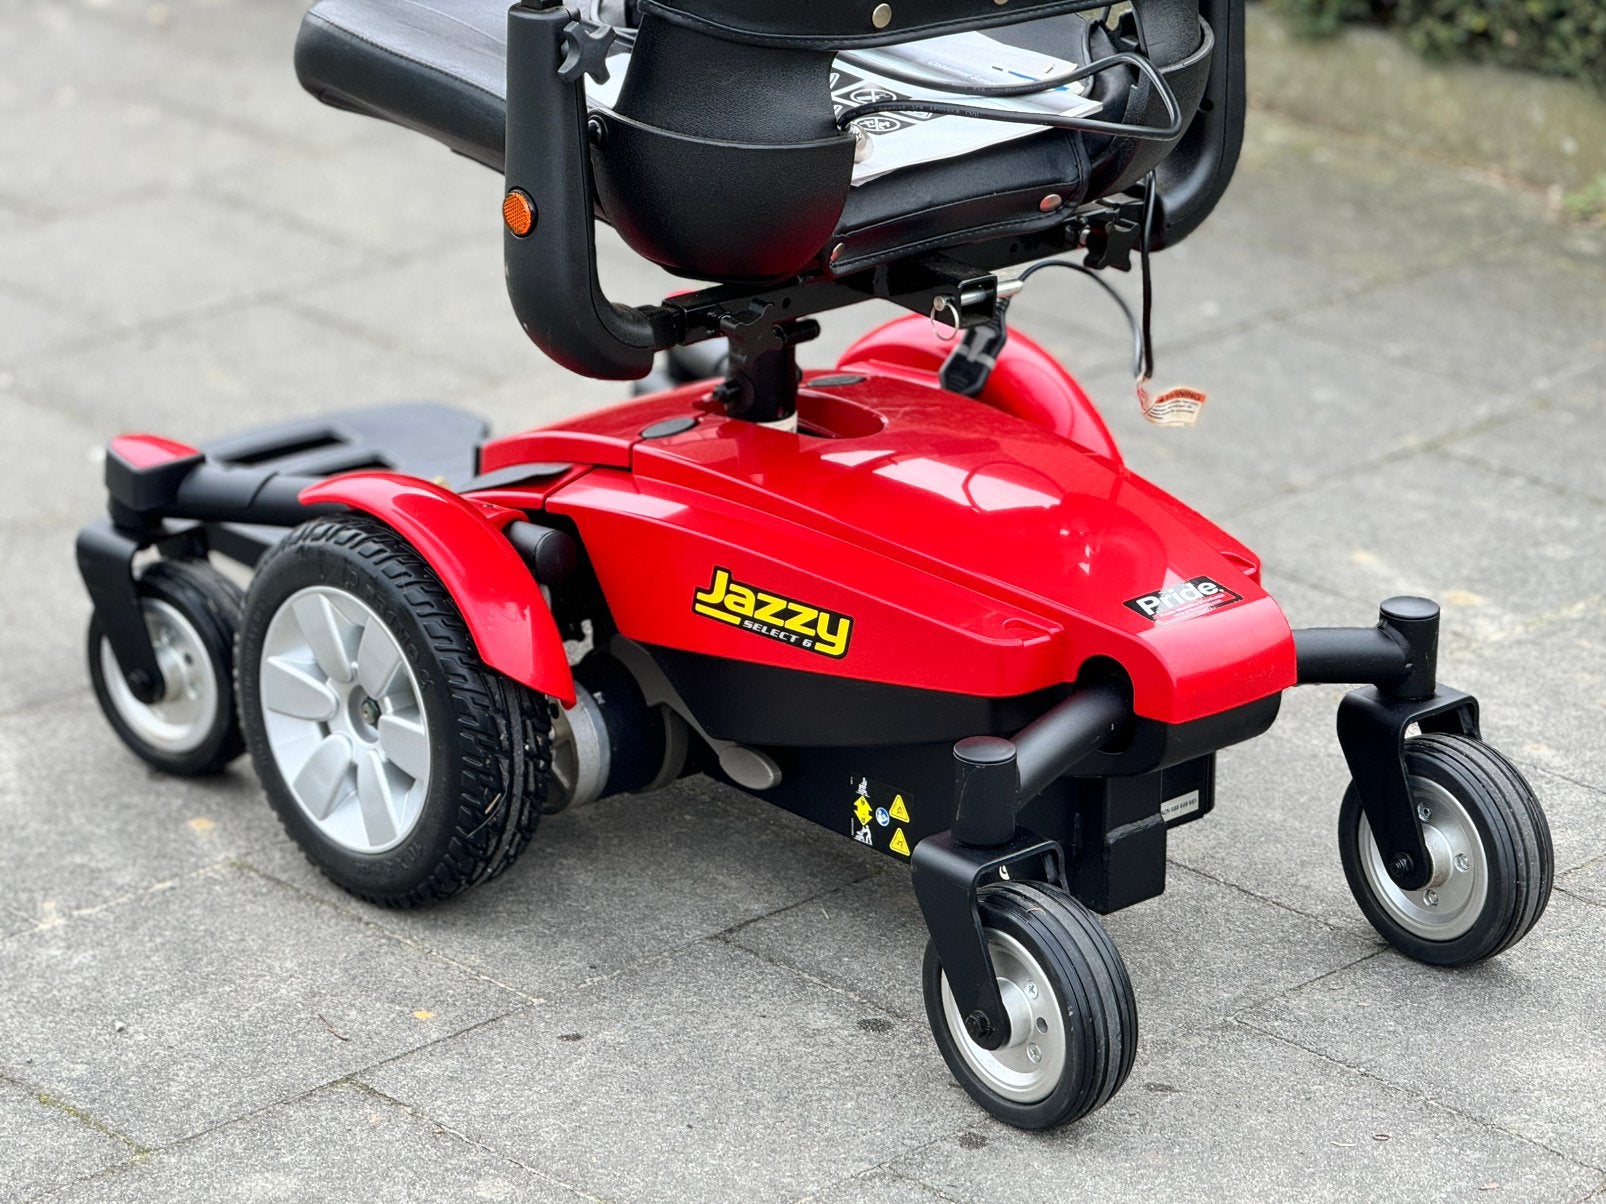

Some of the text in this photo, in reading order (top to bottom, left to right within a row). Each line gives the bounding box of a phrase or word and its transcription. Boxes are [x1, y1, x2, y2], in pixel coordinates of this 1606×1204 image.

[696, 570, 850, 656] Jazzy
[742, 619, 813, 648] SELECT 6
